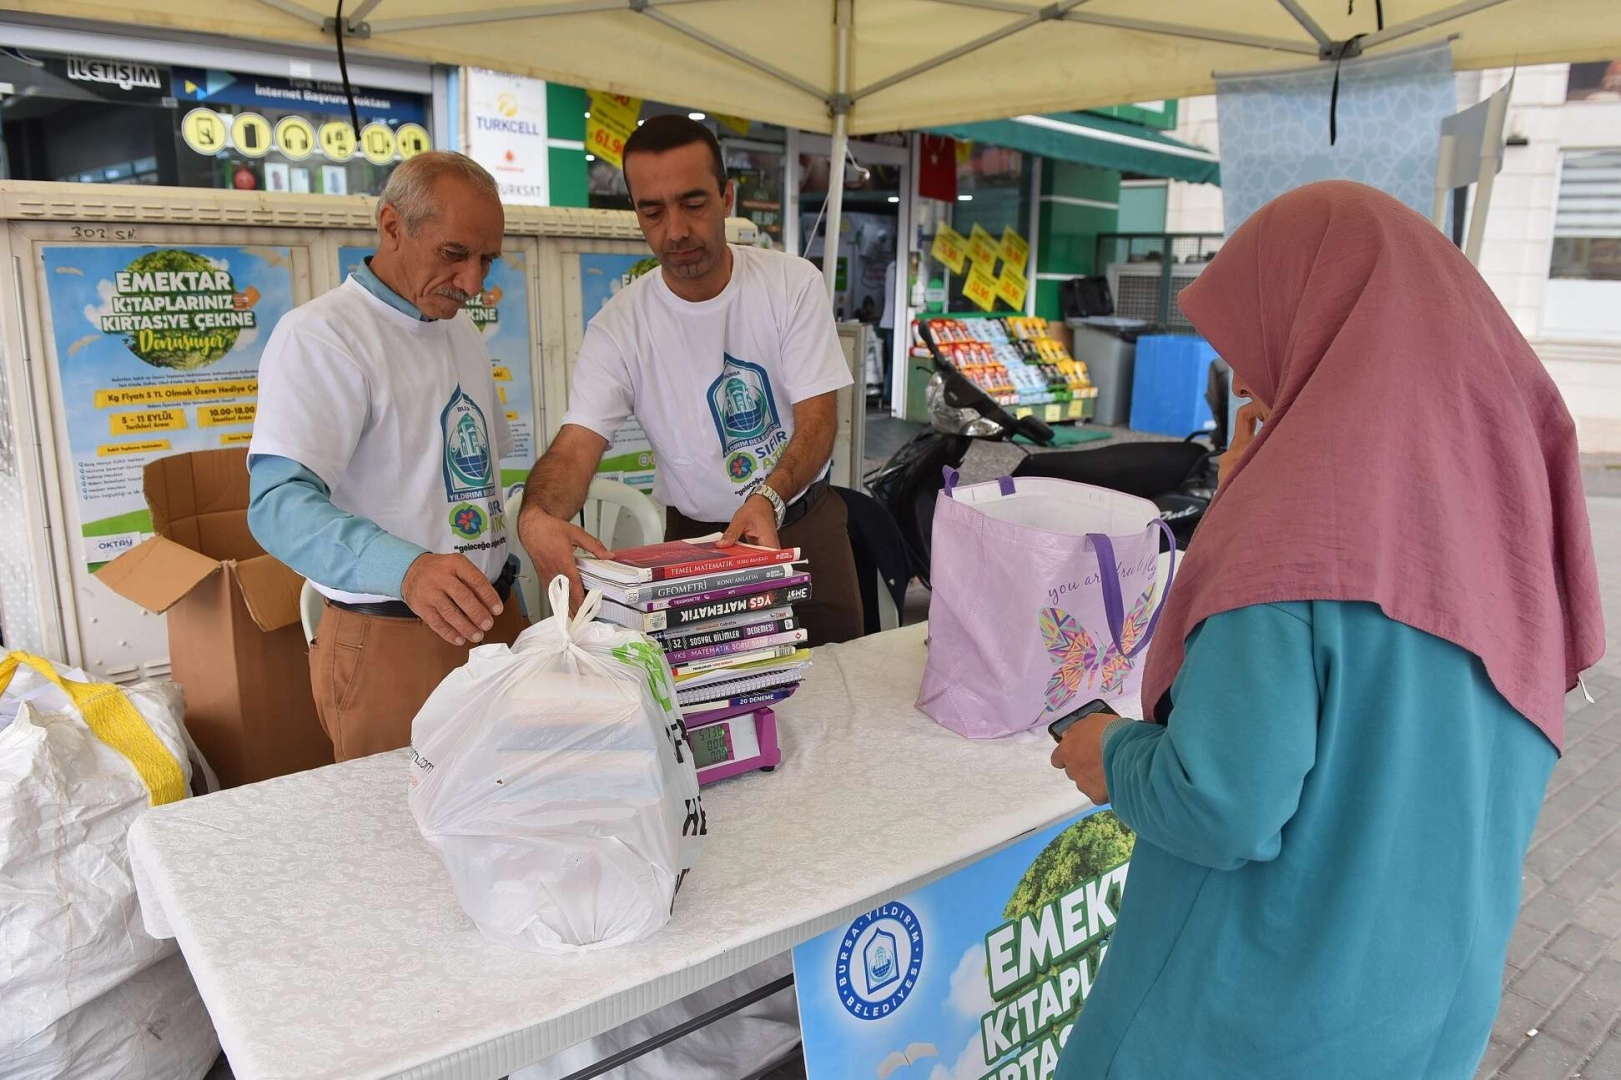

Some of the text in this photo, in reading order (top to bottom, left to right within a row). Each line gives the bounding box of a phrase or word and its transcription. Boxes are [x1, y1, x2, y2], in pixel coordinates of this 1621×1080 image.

[476, 115, 540, 136] TURKCELL
[116, 272, 231, 293] EMEKTAR
[113, 295, 234, 313] KİTAPLARINIZ
[102, 312, 254, 331] KIRTASİYE ÇEKİNE
[107, 394, 119, 402] Kg
[165, 389, 192, 397] Olmak
[194, 386, 216, 396] Üzere
[218, 385, 245, 394] Hediye
[137, 415, 145, 423] 11
[147, 411, 174, 422] EYLÜL
[209, 407, 256, 417] 10.00-18.00
[755, 431, 788, 459] SIFIR
[98, 538, 133, 550] OKTAY
[671, 566, 693, 575] TEMEL
[694, 560, 734, 572] MATEMATİK
[658, 580, 707, 597] GEOMETRİ
[717, 578, 734, 586] KONU
[1048, 583, 1080, 605] you
[1084, 573, 1102, 586] ar
[680, 600, 747, 622] MATEMATİK
[749, 595, 772, 608] YGS
[673, 623, 775, 649] 32 SOSYAL BİLİMLER DENEMESİ
[673, 652, 687, 660] YKS
[691, 645, 730, 657] MATEMATİK
[732, 641, 750, 651] SORU
[749, 694, 774, 703] DENEME
[865, 906, 920, 944] YILDIRIM
[838, 927, 860, 987] BURSA
